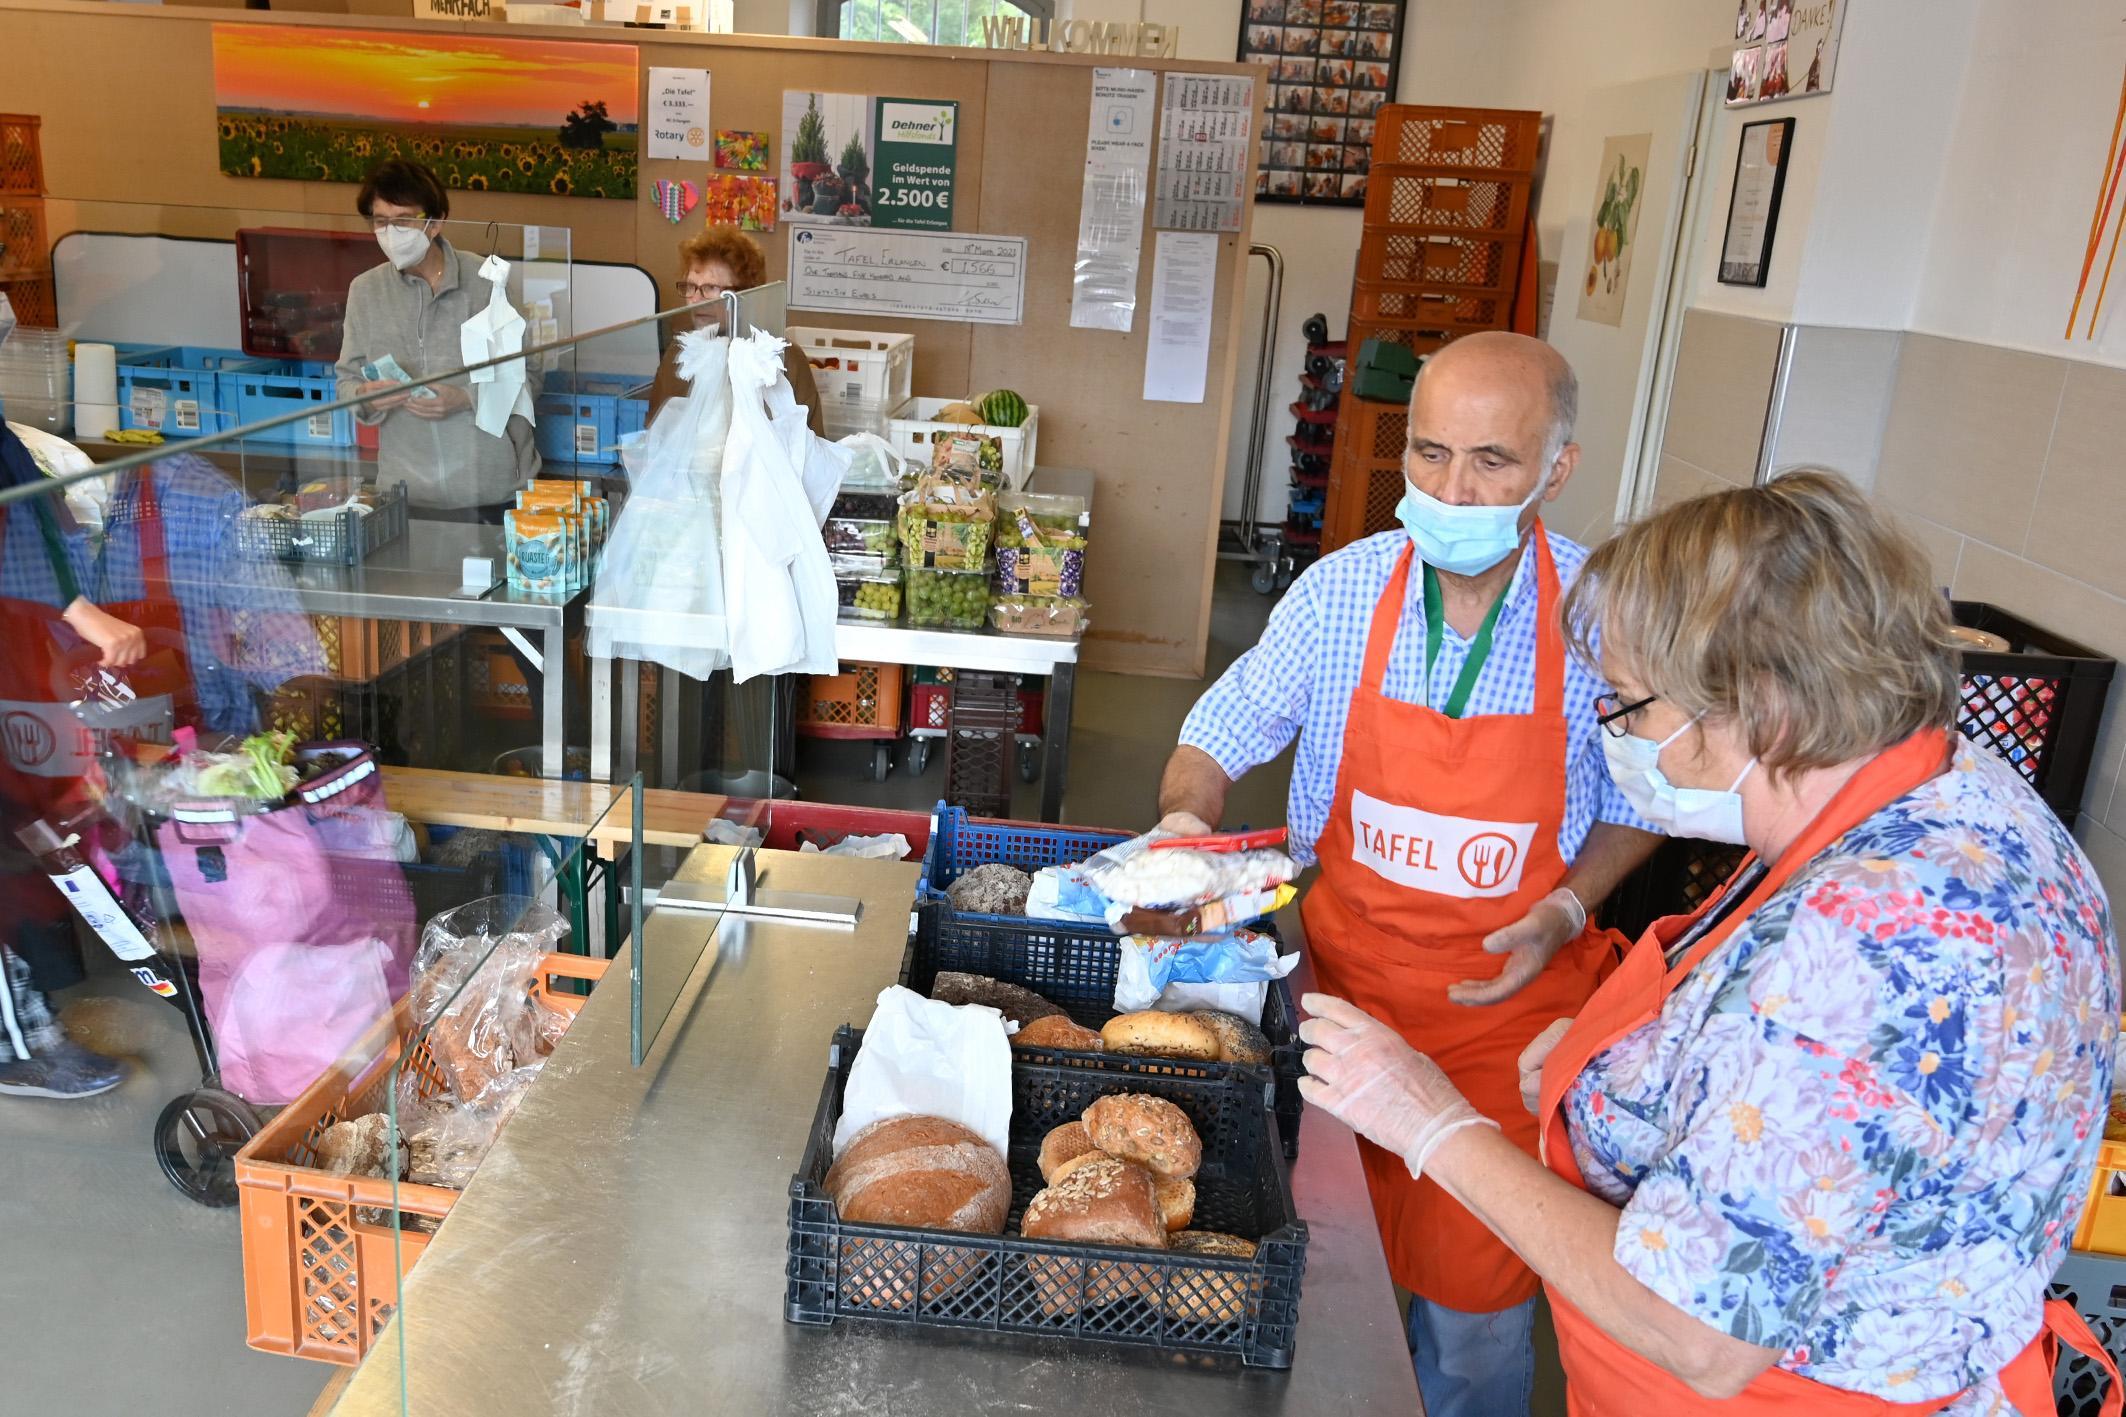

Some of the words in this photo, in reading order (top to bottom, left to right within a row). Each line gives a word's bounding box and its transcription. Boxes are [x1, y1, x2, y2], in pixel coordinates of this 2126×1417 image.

[981, 15, 1179, 59] WILLKOMMEN
[892, 120, 936, 132] Dehner
[655, 130, 684, 142] Rotary
[892, 162, 952, 175] Geldspende
[892, 175, 904, 184] im
[906, 176, 930, 186] Wert
[932, 178, 950, 186] von
[834, 246, 876, 265] TAFEL
[941, 261, 950, 272] €
[1359, 820, 1438, 871] TAFEL
